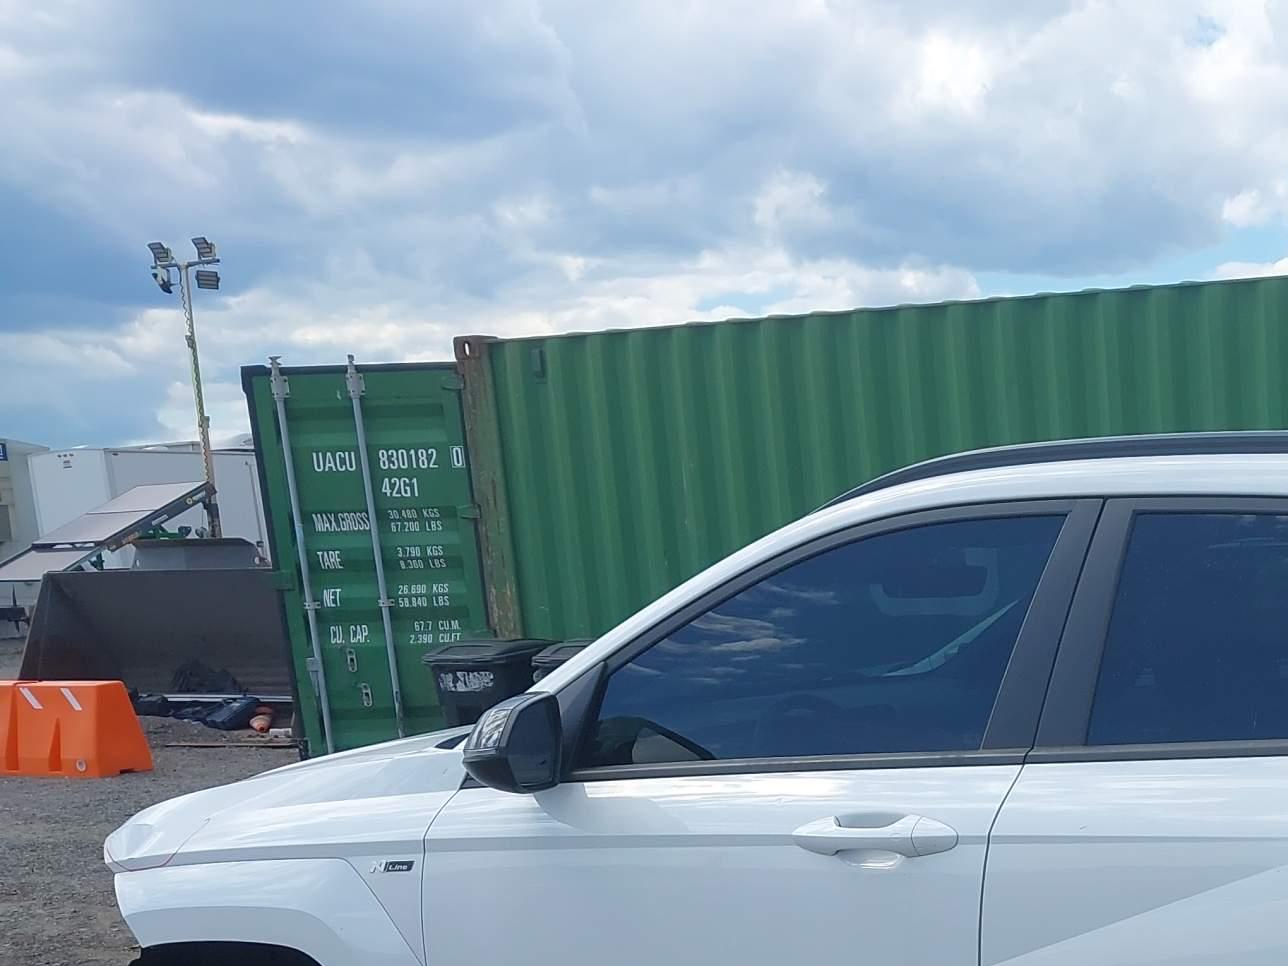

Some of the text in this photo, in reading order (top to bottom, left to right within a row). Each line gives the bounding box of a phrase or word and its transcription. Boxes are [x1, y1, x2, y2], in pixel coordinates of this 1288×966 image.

[312, 446, 464, 472] UACU 830182 0
[381, 477, 419, 498] 42G1
[312, 508, 440, 532] MAX.GROSS 30.480 KGS
[390, 520, 442, 532] 67.200 LBS
[316, 545, 444, 570] TARE 3.790 KGS
[429, 558, 447, 569] LBS
[323, 583, 449, 607] NET 26.690 KGS
[432, 595, 450, 606] LBS
[330, 625, 345, 644] CU.
[350, 624, 370, 643] CAP.
[414, 620, 432, 632] 67.7
[409, 634, 433, 644] 2.390
